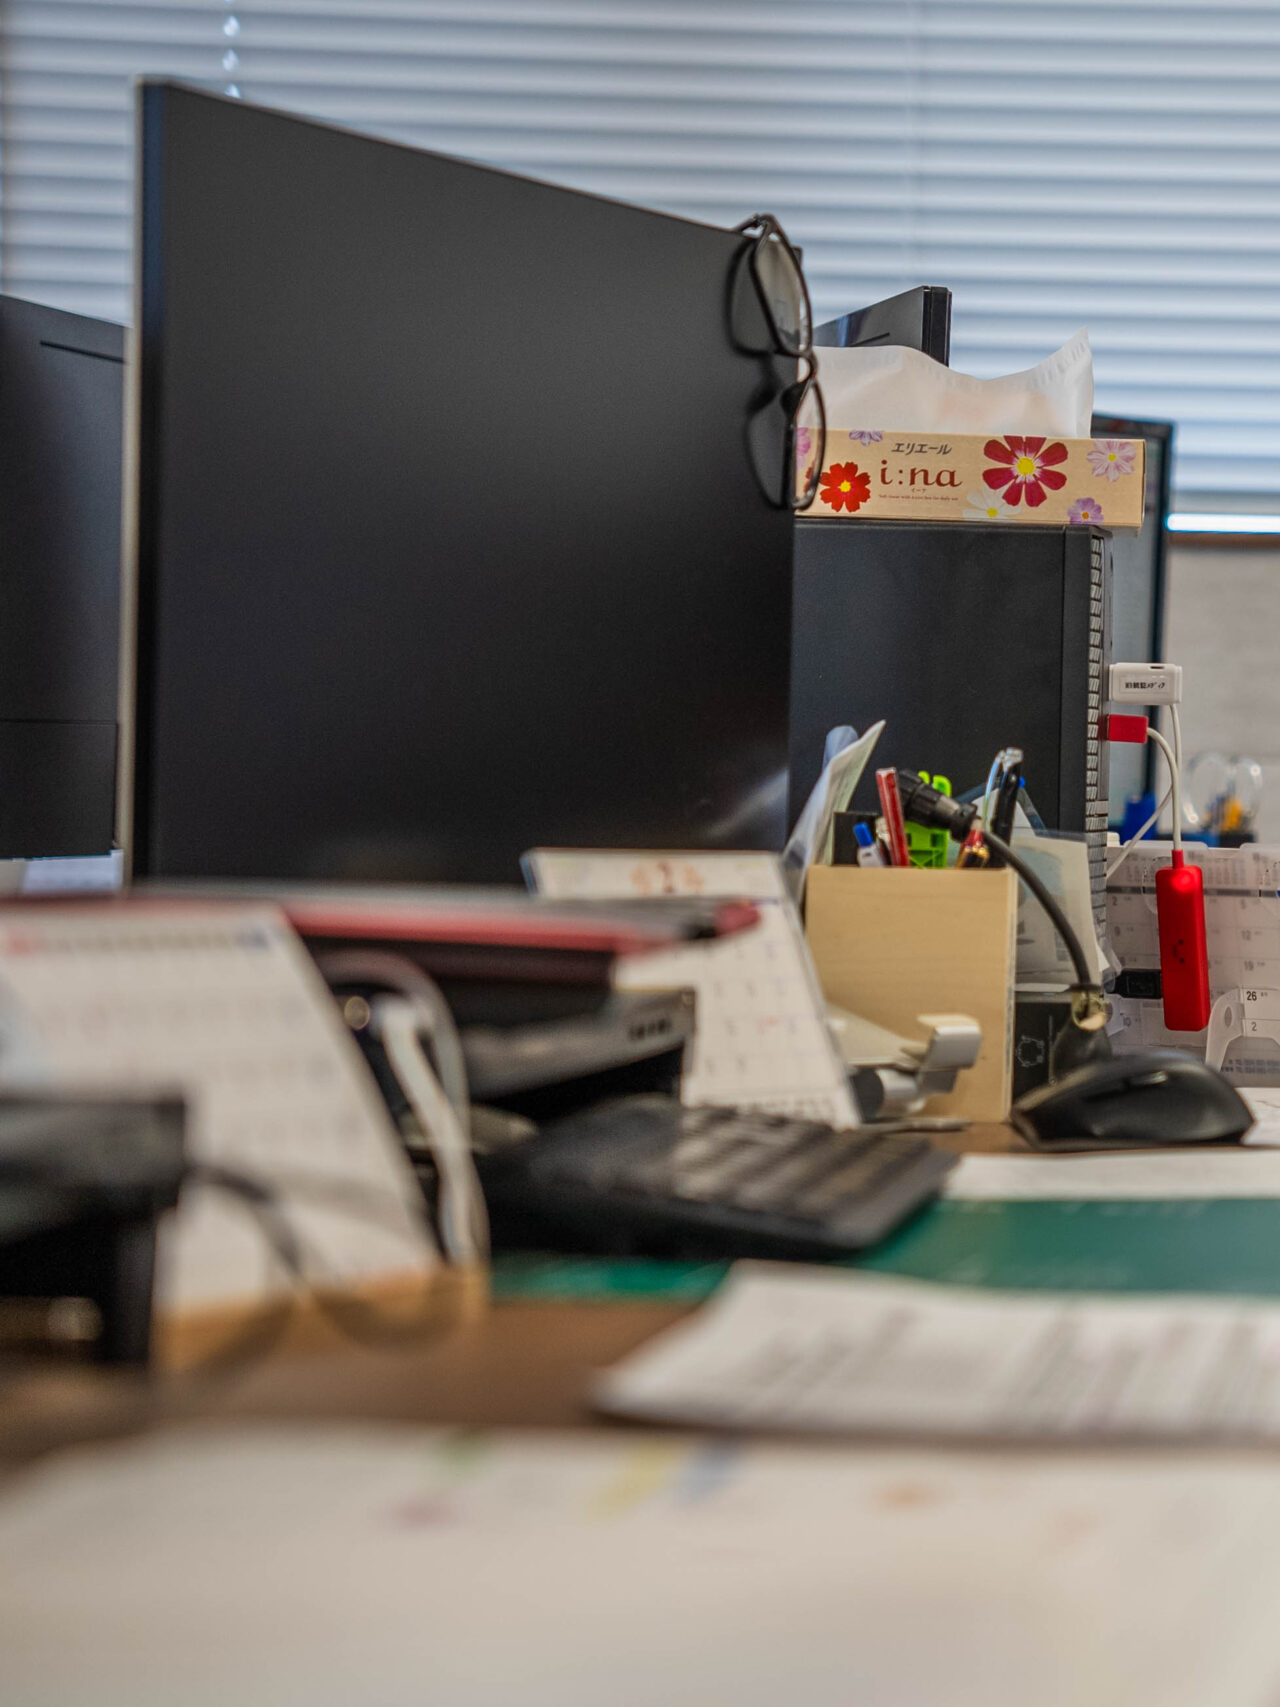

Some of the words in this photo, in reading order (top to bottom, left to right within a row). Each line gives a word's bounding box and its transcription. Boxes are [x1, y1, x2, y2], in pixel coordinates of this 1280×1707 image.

[891, 443, 952, 455] エリエール
[1246, 990, 1257, 1002] 26
[1251, 1021, 1258, 1032] 2
